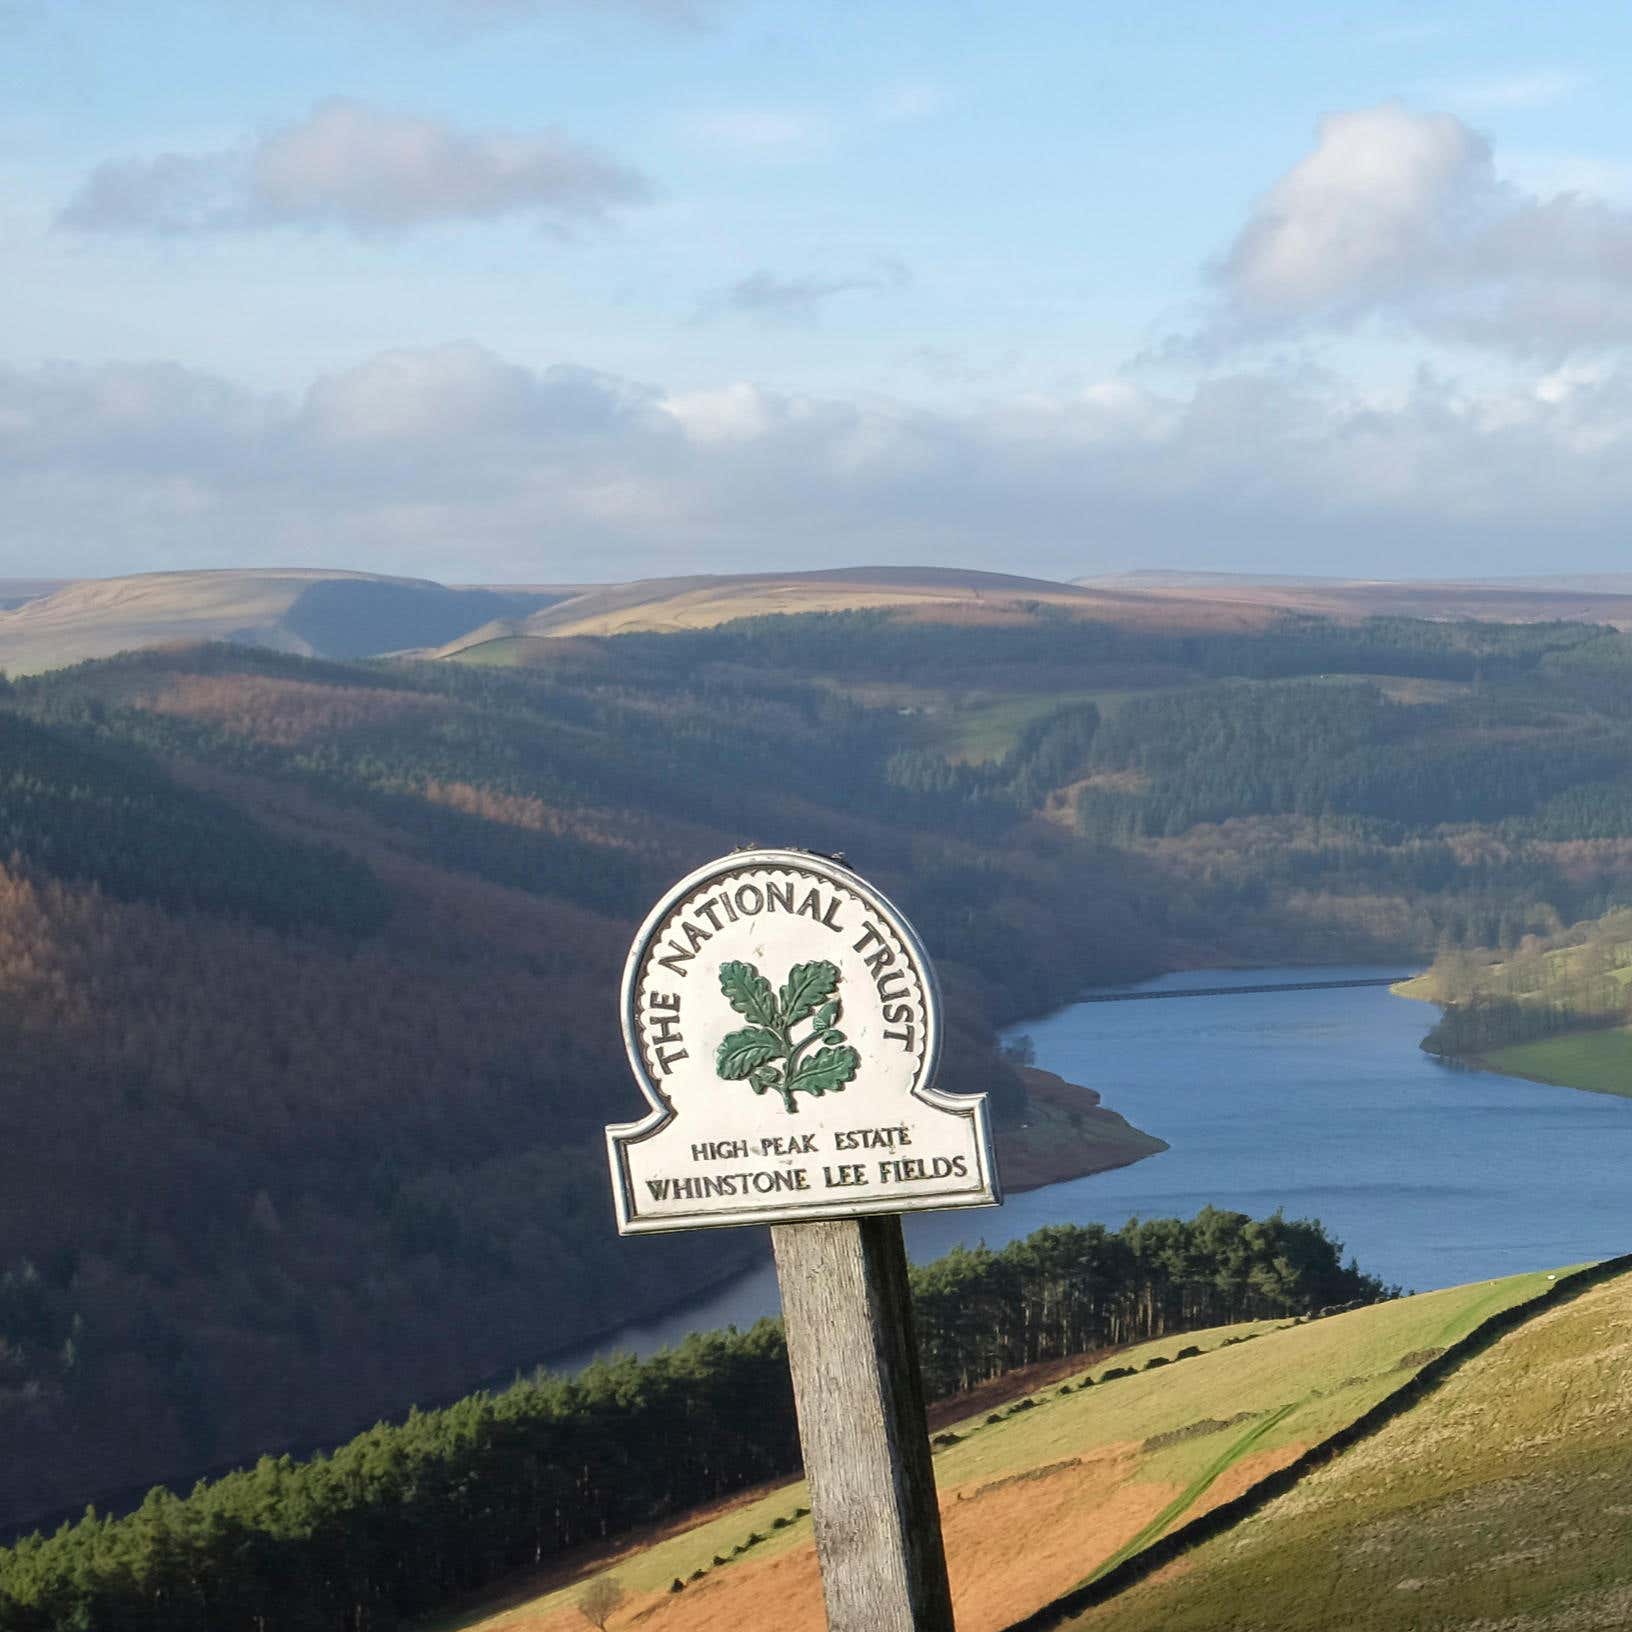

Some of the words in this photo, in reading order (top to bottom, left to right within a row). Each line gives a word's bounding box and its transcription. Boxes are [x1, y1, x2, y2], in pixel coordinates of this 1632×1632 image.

[658, 881, 845, 977] NATIONAL
[852, 920, 915, 1053] TRUST
[649, 990, 689, 1075] THE
[646, 1168, 811, 1202] WHINSTONE
[824, 1163, 866, 1188] LEE
[879, 1155, 968, 1184] FIELDS
[691, 1139, 748, 1162] HIGH
[761, 1133, 819, 1155] PEAK
[834, 1126, 912, 1151] ESTATE
